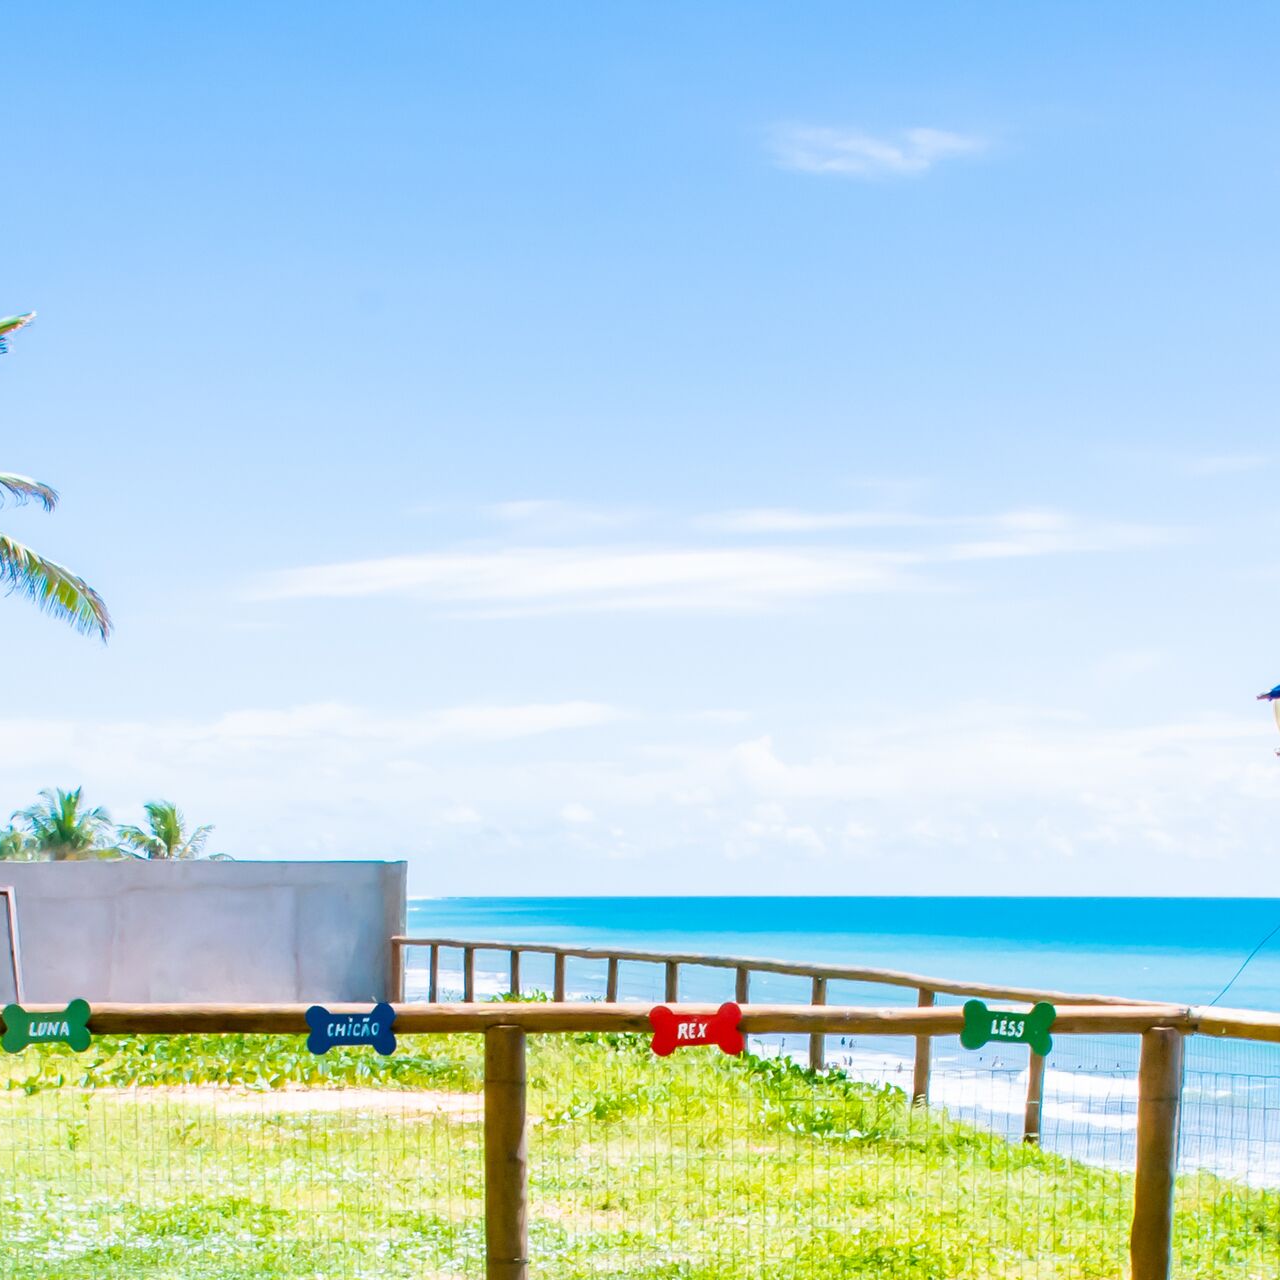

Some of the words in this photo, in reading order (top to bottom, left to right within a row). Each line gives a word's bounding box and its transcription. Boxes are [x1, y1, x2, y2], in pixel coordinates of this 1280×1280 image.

[28, 1021, 70, 1037] LUNA
[677, 1023, 708, 1040] REX
[990, 1019, 1025, 1038] LESS
